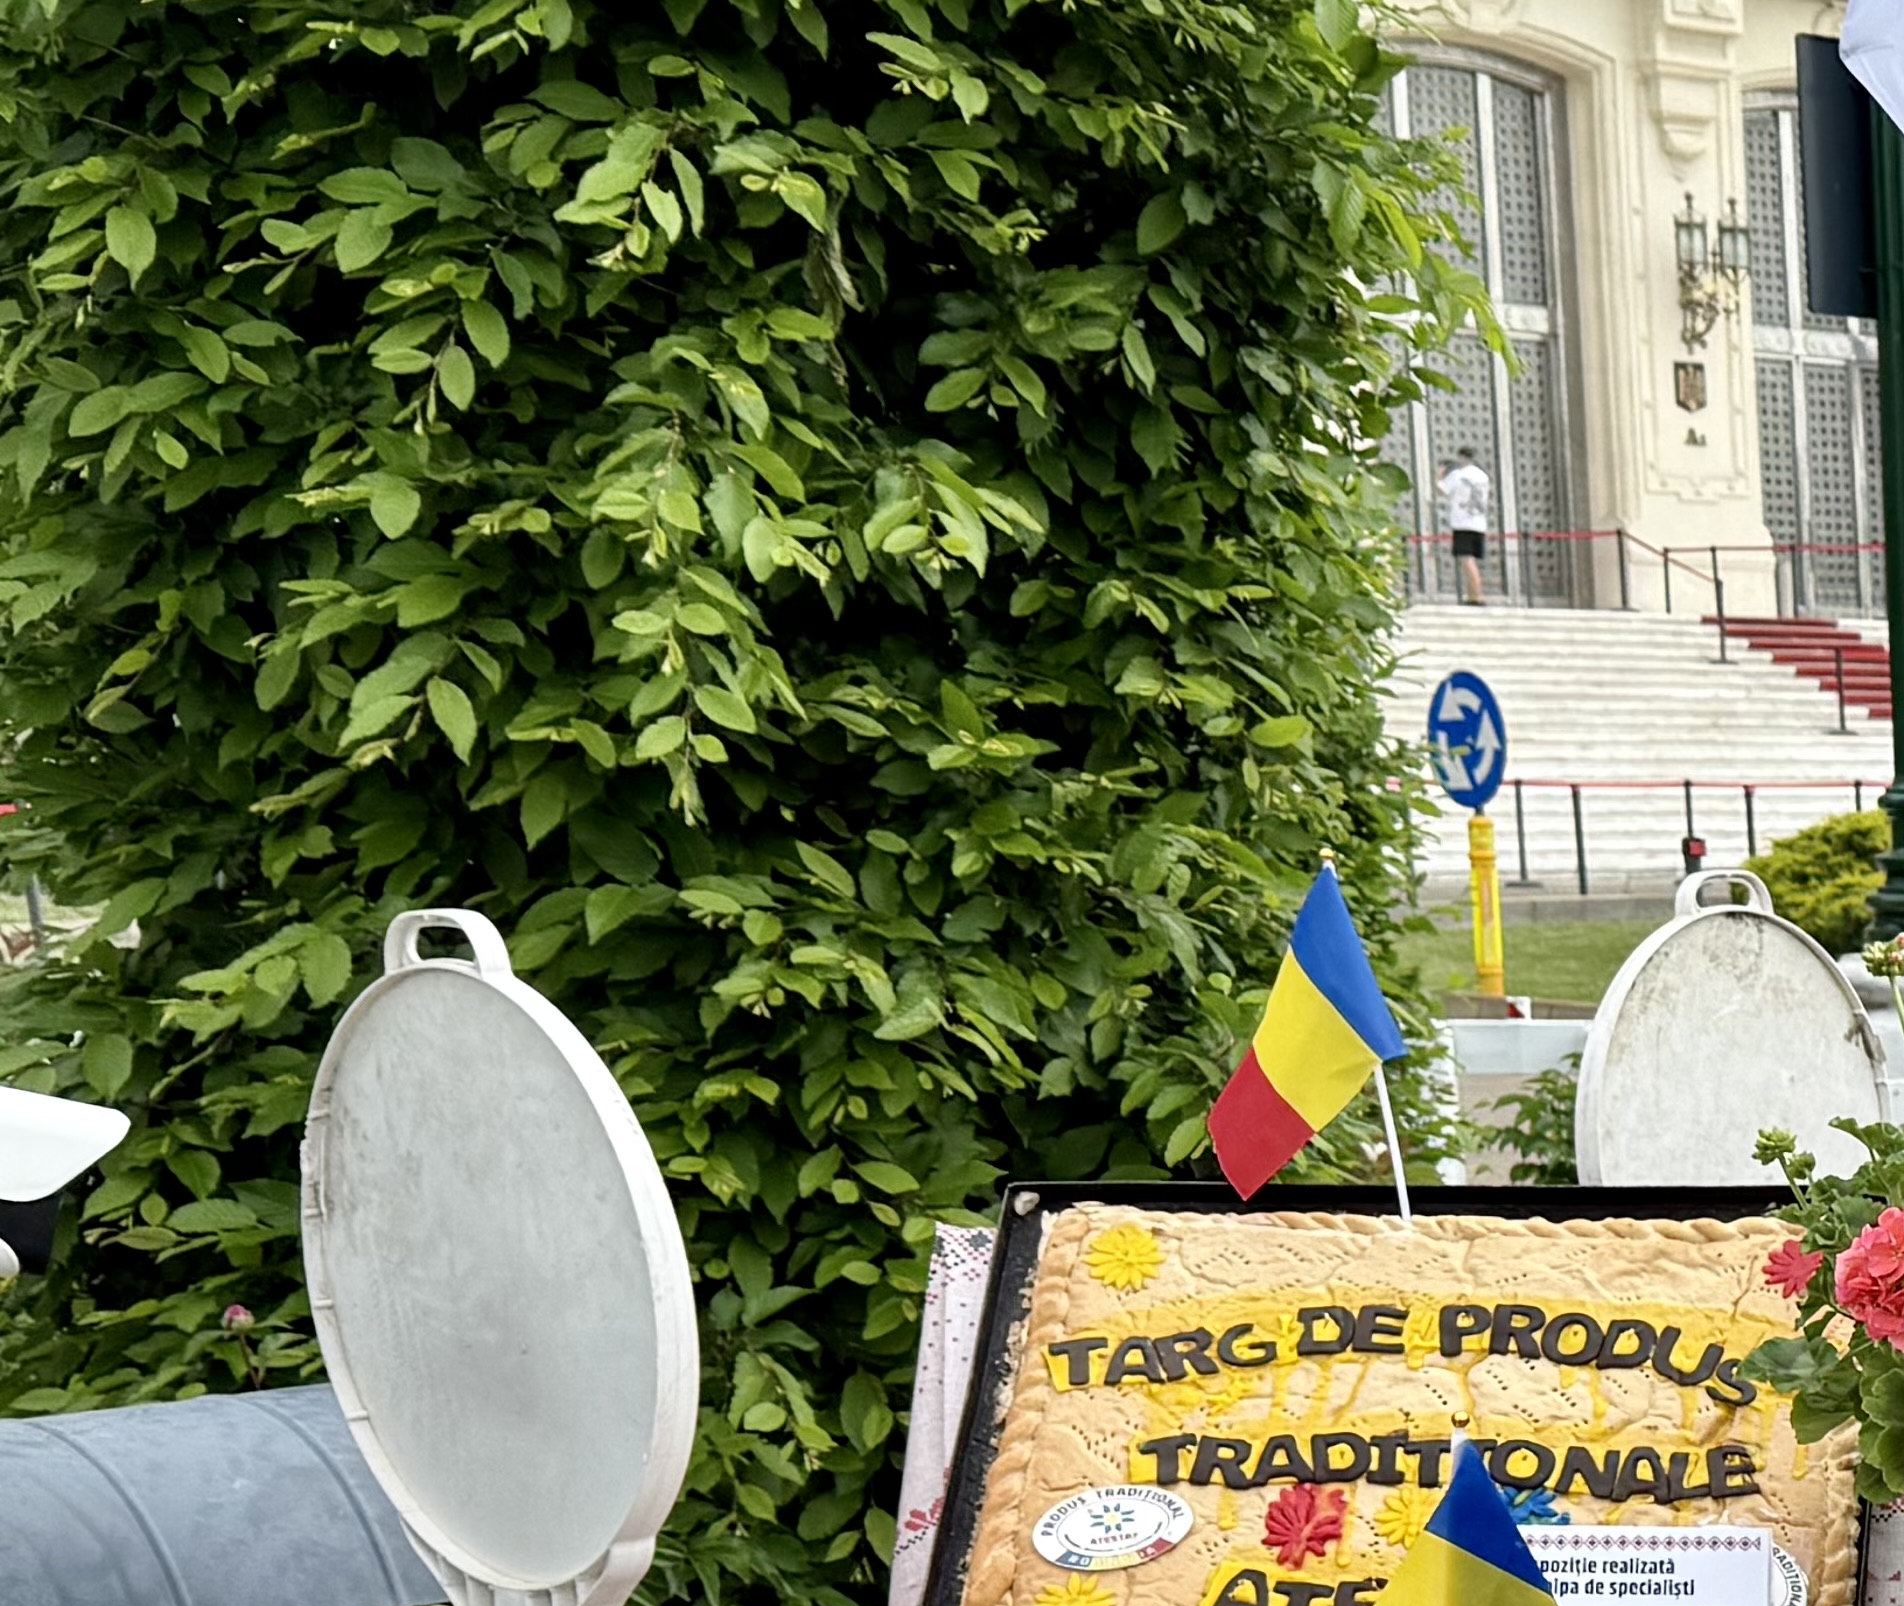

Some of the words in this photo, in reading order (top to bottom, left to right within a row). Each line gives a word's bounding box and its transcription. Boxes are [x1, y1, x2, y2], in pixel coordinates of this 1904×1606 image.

[1048, 1323, 1277, 1386] TARG
[1297, 1304, 1407, 1356] DE
[1041, 1495, 1087, 1536] PRODUS
[1540, 1556, 1597, 1577] poziție
[1602, 1556, 1675, 1574] realizată
[1585, 1579, 1604, 1595] de
[1609, 1578, 1695, 1599] specialiști
